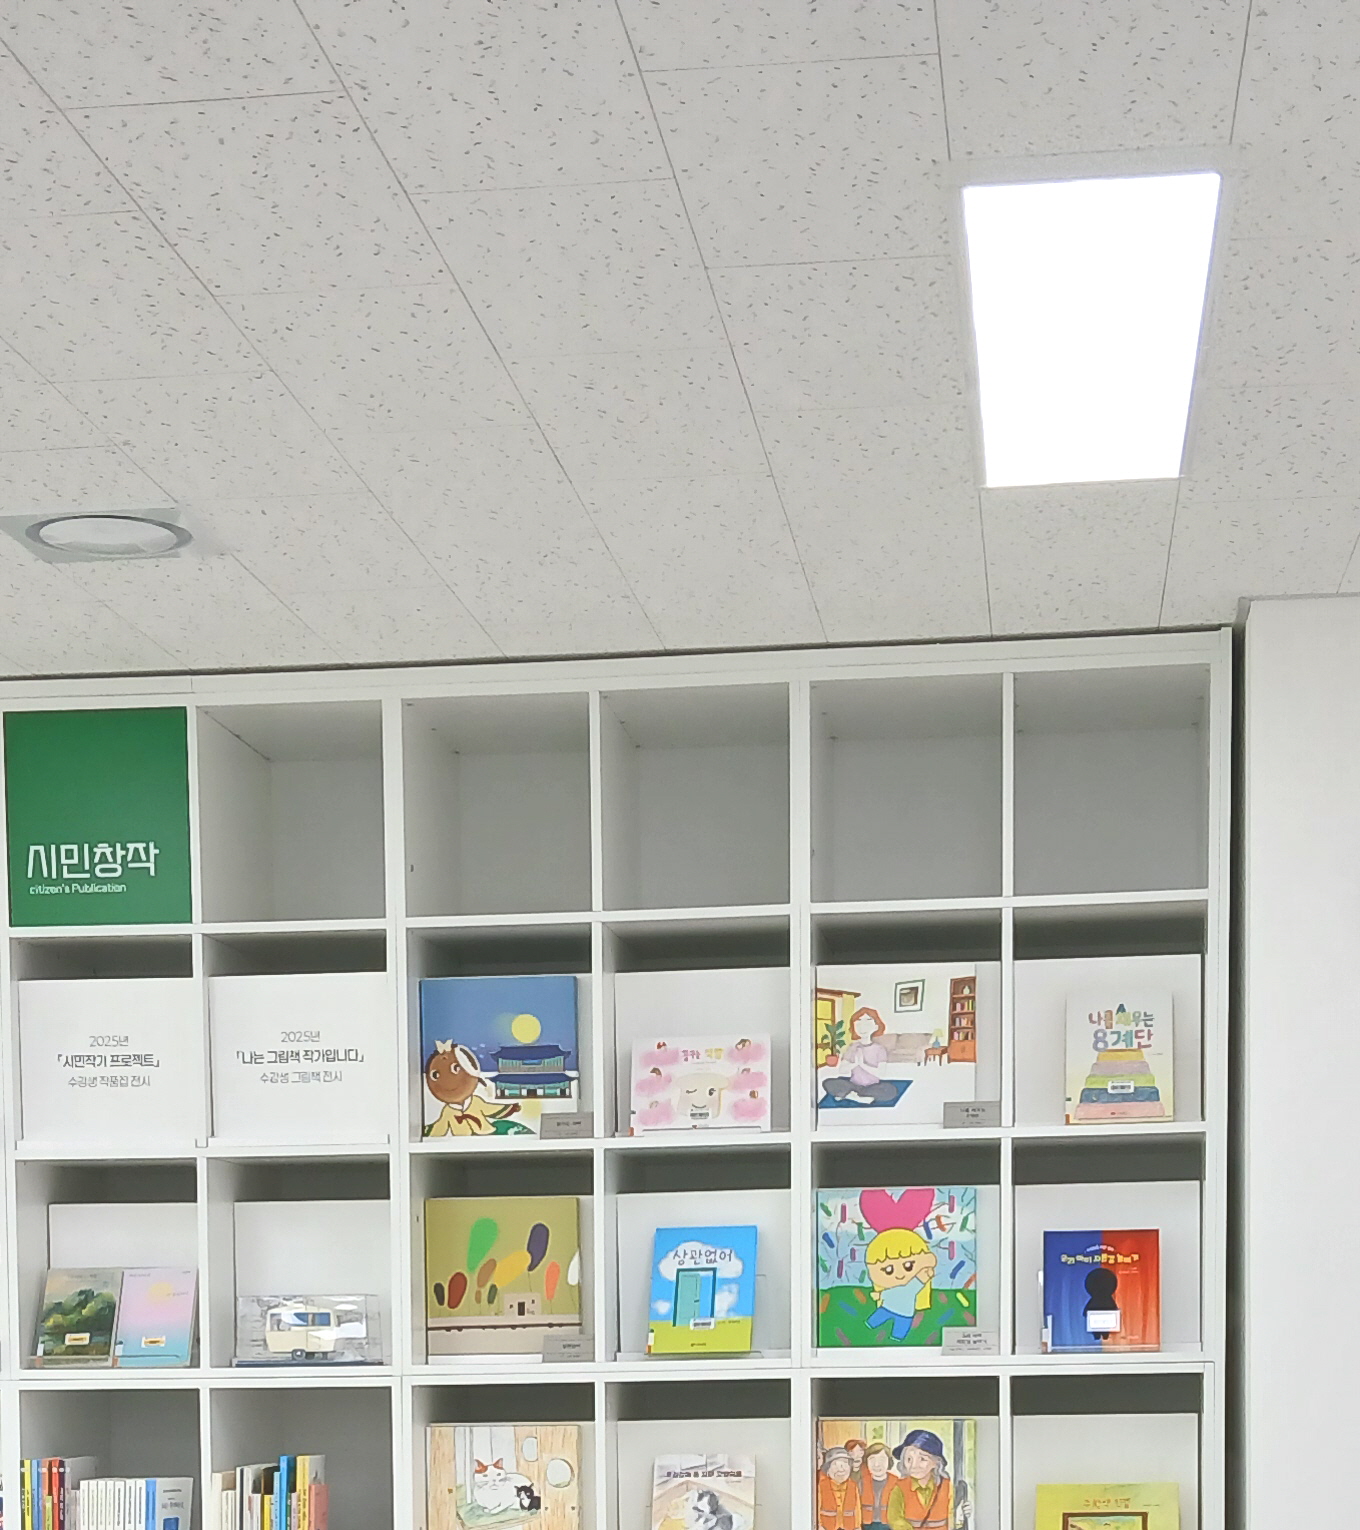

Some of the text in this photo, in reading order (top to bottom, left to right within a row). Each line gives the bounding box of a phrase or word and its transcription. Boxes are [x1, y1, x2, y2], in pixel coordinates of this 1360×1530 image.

[27, 842, 160, 879] 시민창작
[72, 883, 127, 895] Publication
[88, 1035, 129, 1048] 2025년
[280, 1031, 321, 1043] 2025년
[267, 1050, 301, 1064] 그림책
[673, 1249, 733, 1266] 상관없어
